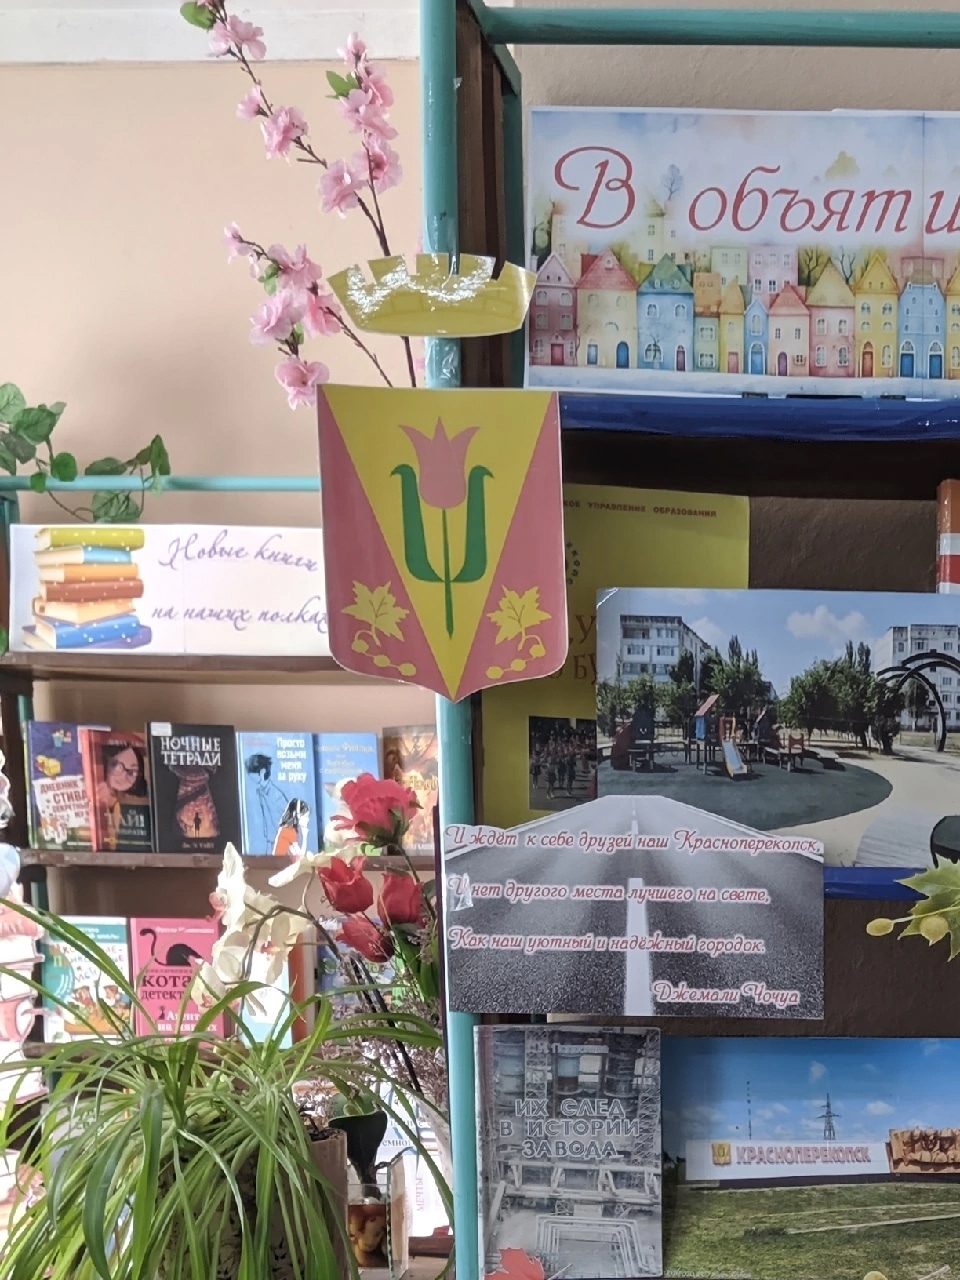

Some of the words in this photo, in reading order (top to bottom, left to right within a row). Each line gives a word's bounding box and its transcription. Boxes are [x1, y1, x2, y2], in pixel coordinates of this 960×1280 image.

[554, 145, 637, 230] В
[588, 502, 646, 512] УПРАВЛЕНИЕ
[653, 506, 717, 518] ОБРАЗОВАНИЯ
[158, 528, 248, 570] Новые
[254, 534, 318, 571] книги
[151, 607, 178, 620] на
[184, 605, 251, 631] наших
[160, 736, 221, 752] НОЧНЫЕ
[277, 737, 305, 749] Просто
[160, 750, 221, 766] ТЕТРАДИ
[277, 750, 307, 760] возьми
[281, 761, 302, 770] меня
[288, 771, 307, 783] руку
[40, 780, 79, 794] ДНЕВНИК
[468, 830, 517, 847] ждёт
[526, 835, 537, 847] к
[540, 831, 574, 847] себе
[579, 831, 632, 851] друзей
[637, 835, 668, 848] наш
[673, 830, 822, 854] Красноперекопск,
[471, 885, 500, 899] нет
[505, 880, 568, 902] другого
[572, 886, 623, 900] места
[628, 886, 693, 904] лучшего
[697, 889, 717, 901] на
[721, 888, 770, 904] свете,
[449, 928, 487, 949] Как
[490, 936, 522, 949] наш
[524, 934, 592, 953] уютный
[595, 938, 607, 950] и
[610, 934, 694, 952] надёжный
[698, 936, 765, 957] городок.
[654, 981, 738, 1004] Джемали
[741, 983, 799, 1007] Чочуа
[167, 1011, 200, 1021] Аент
[514, 1098, 549, 1117] ИХ
[561, 1099, 626, 1118] СЛЕД
[500, 1120, 514, 1137] В
[528, 1119, 640, 1137] ИСТОРИИ
[522, 1140, 617, 1160] ЗАВОДА
[736, 1146, 872, 1165] КРАСНОПЕРЕКОПСК
